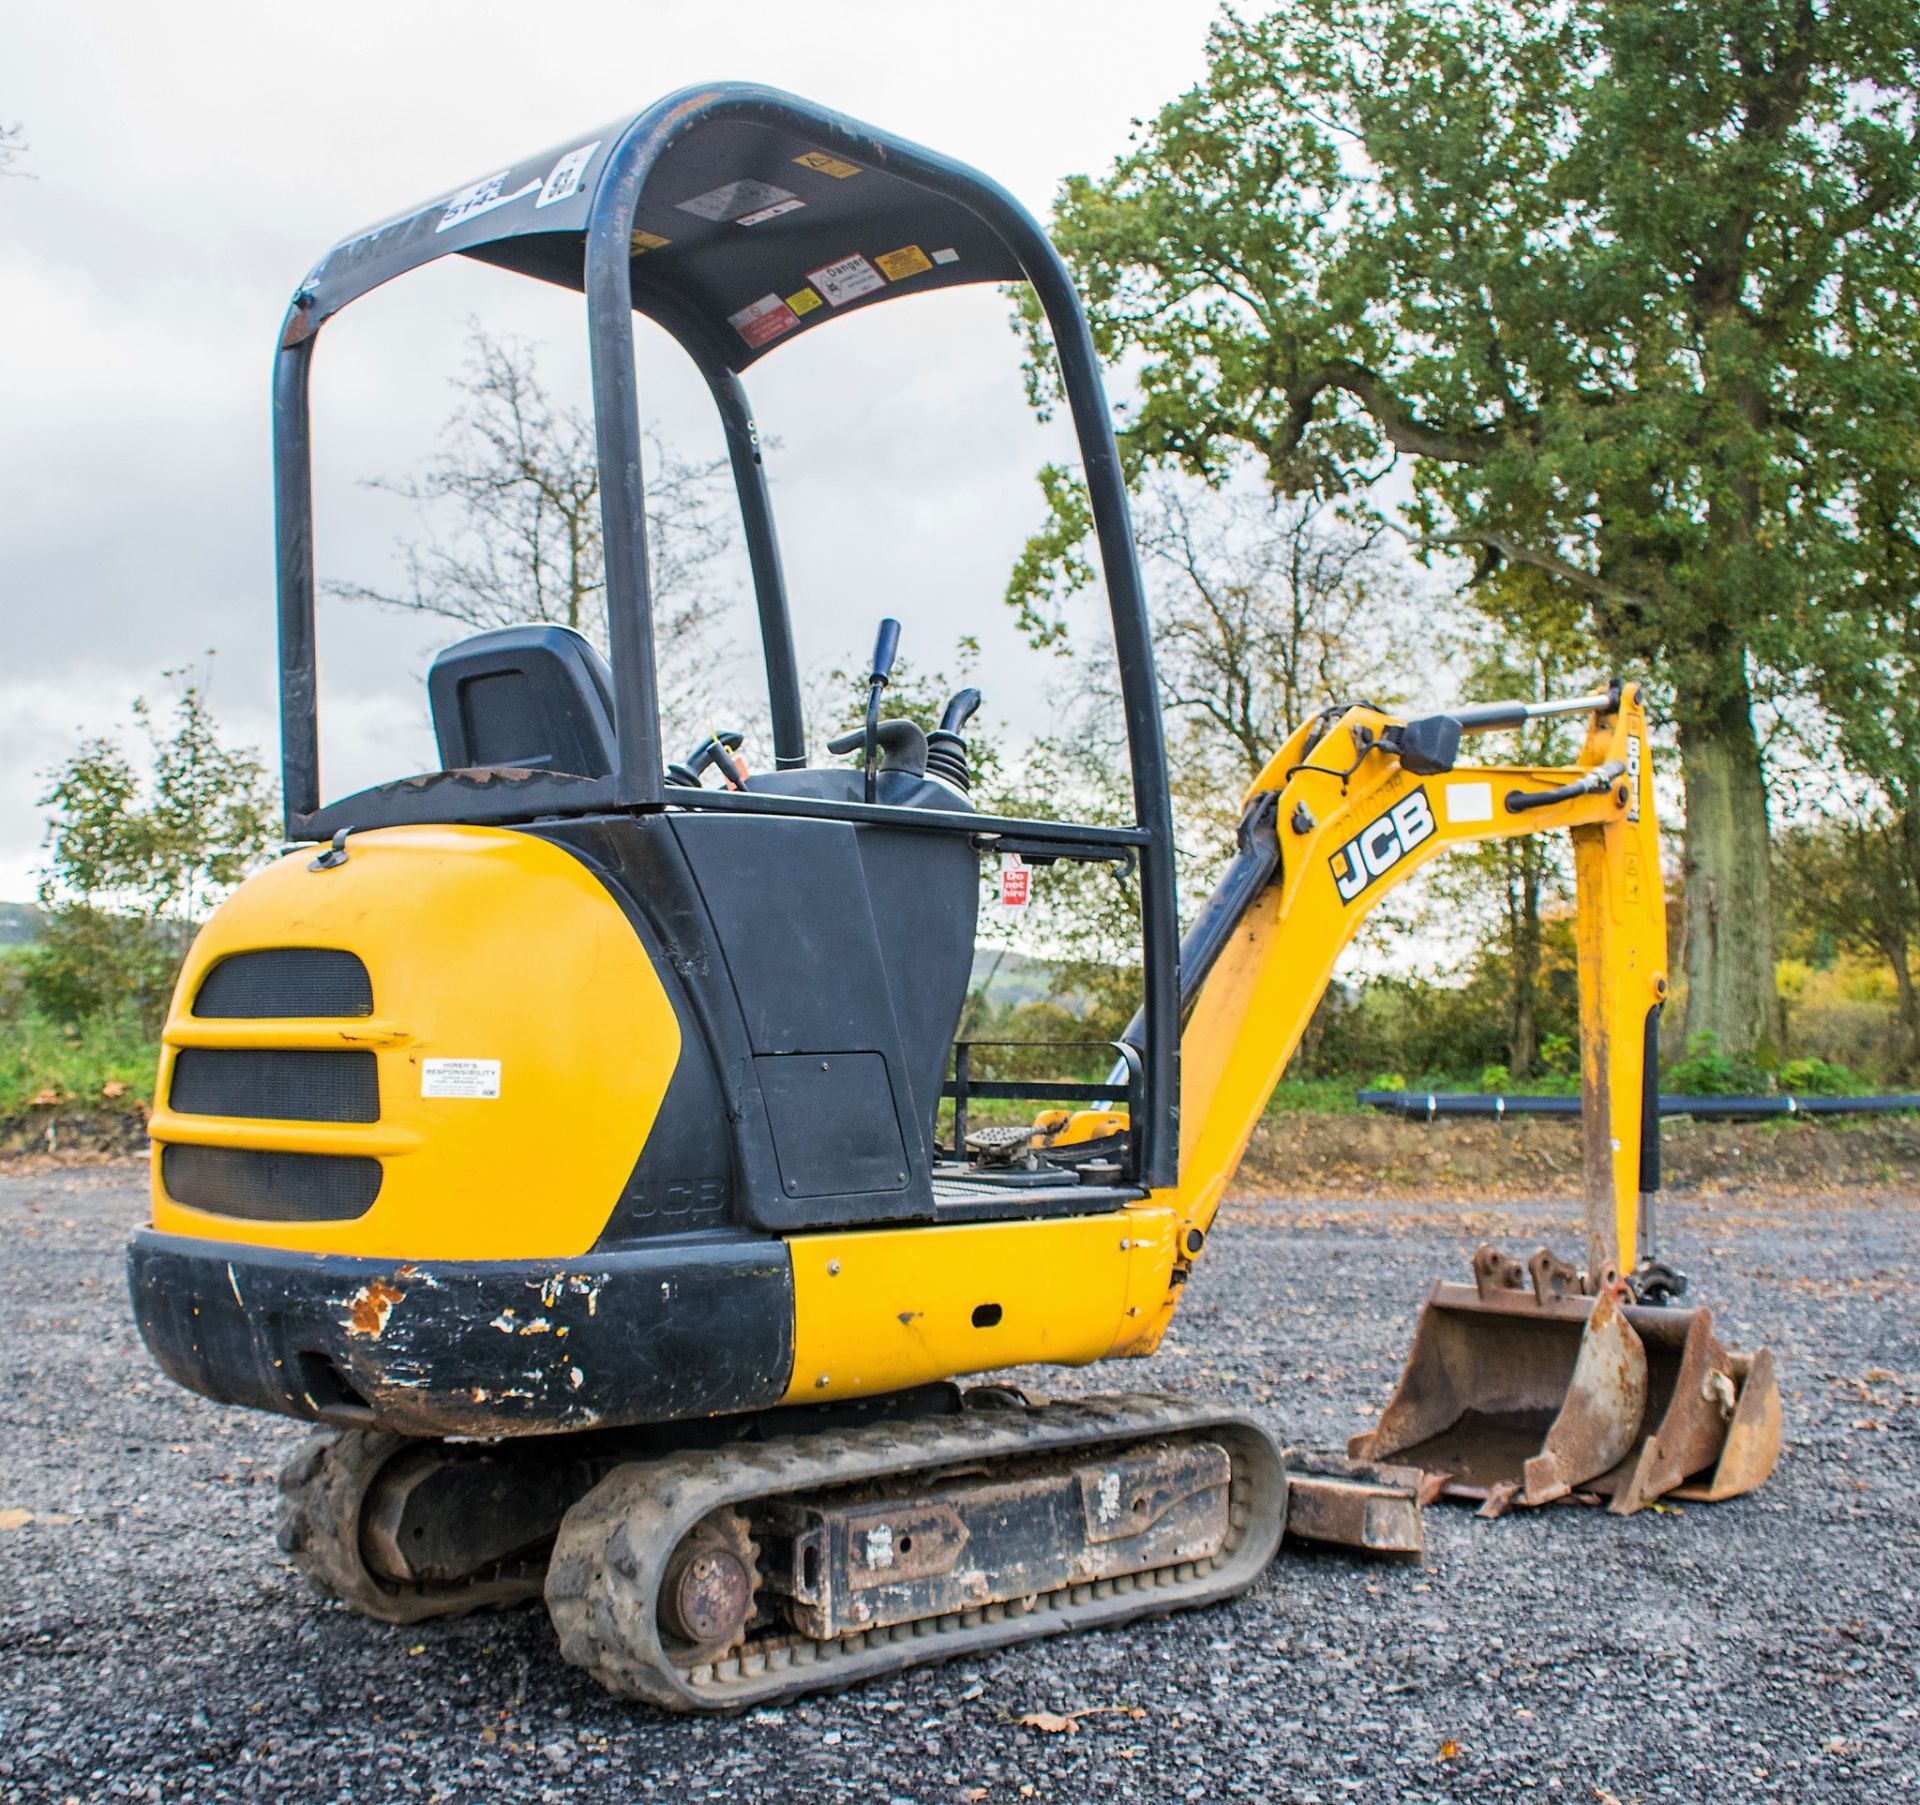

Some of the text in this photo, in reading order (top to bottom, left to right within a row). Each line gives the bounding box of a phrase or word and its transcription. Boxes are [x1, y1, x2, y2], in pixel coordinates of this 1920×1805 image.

[826, 256, 866, 278] Danger
[1337, 791, 1435, 900] JCB
[1006, 871, 1024, 880] Do
[1005, 880, 1025, 889] not
[1004, 889, 1026, 897] hire
[632, 1184, 725, 1217] JCB
